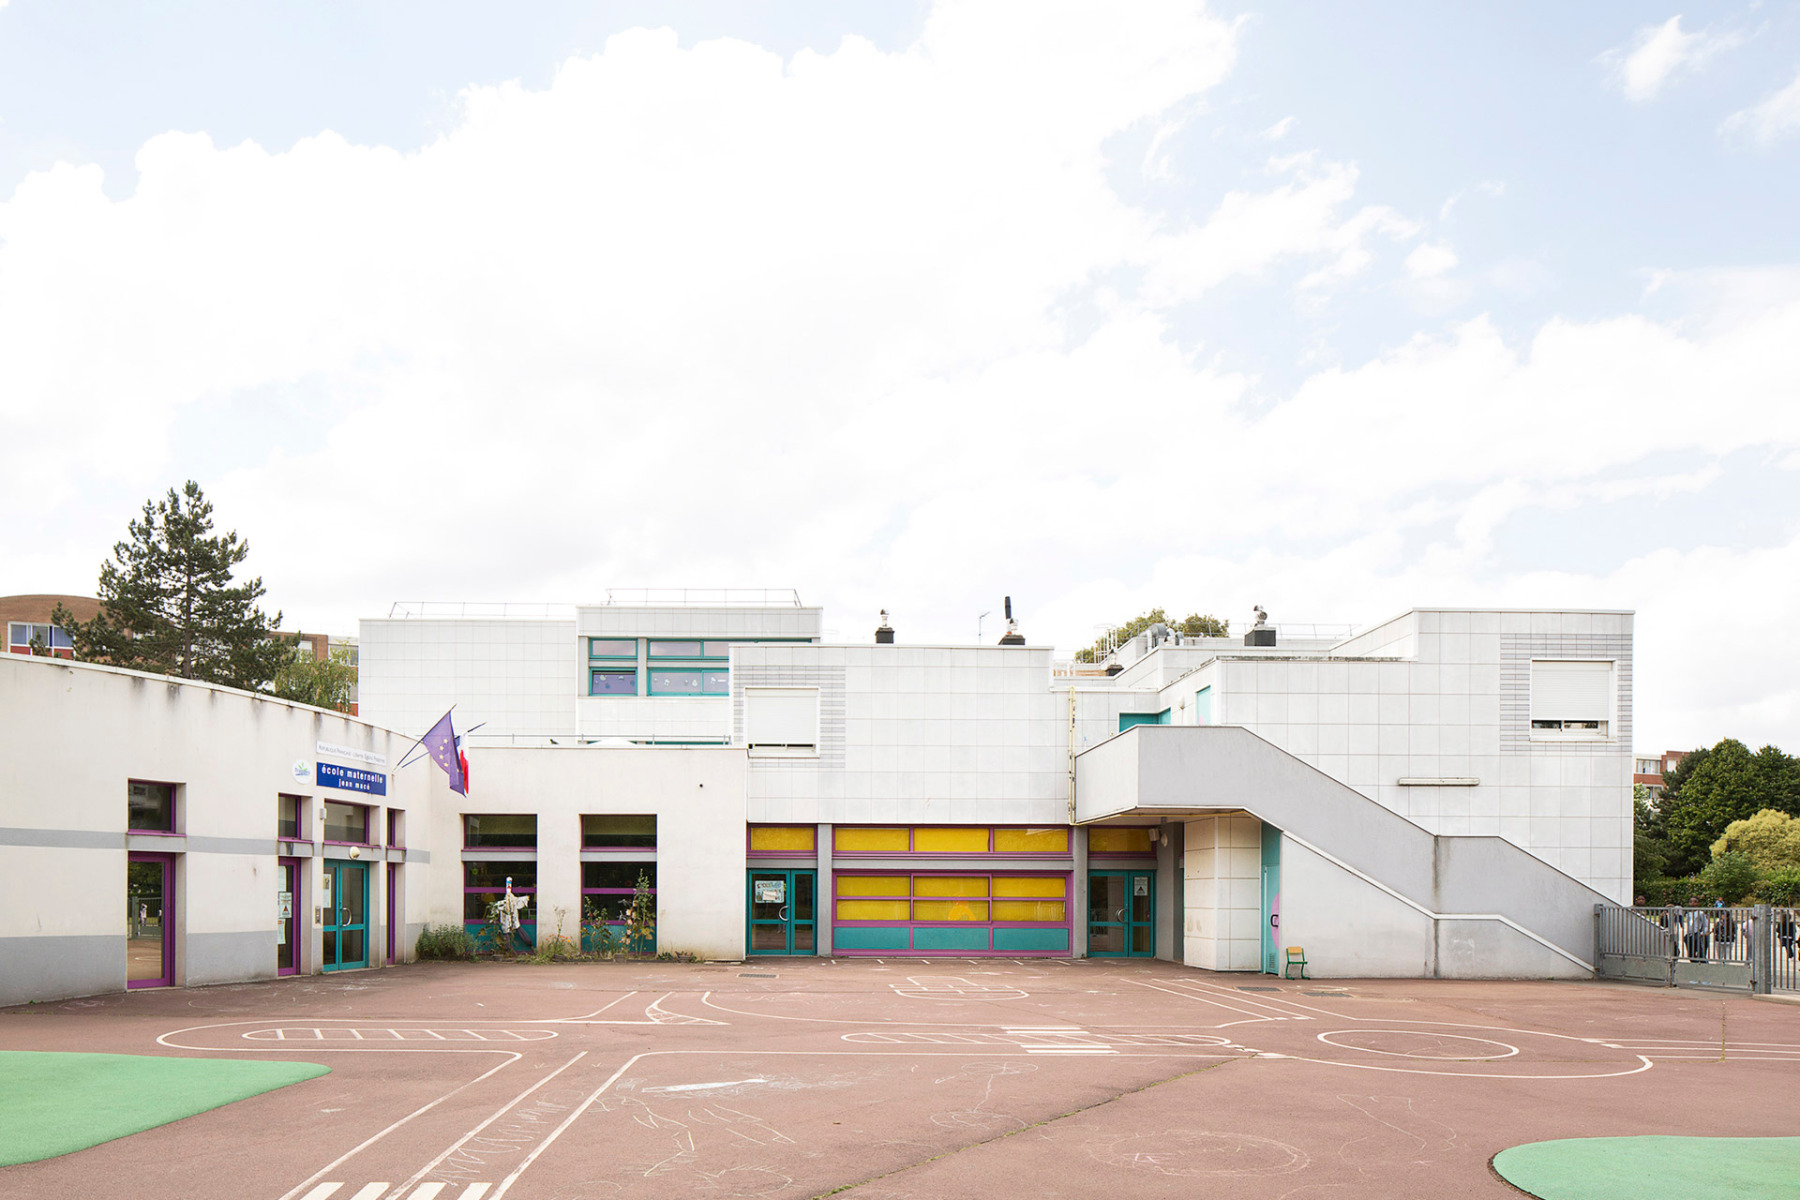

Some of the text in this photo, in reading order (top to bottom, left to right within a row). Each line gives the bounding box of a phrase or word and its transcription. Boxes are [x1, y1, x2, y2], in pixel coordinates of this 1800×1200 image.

[321, 764, 344, 777] école
[346, 770, 383, 784] maternelle
[338, 778, 353, 788] jean
